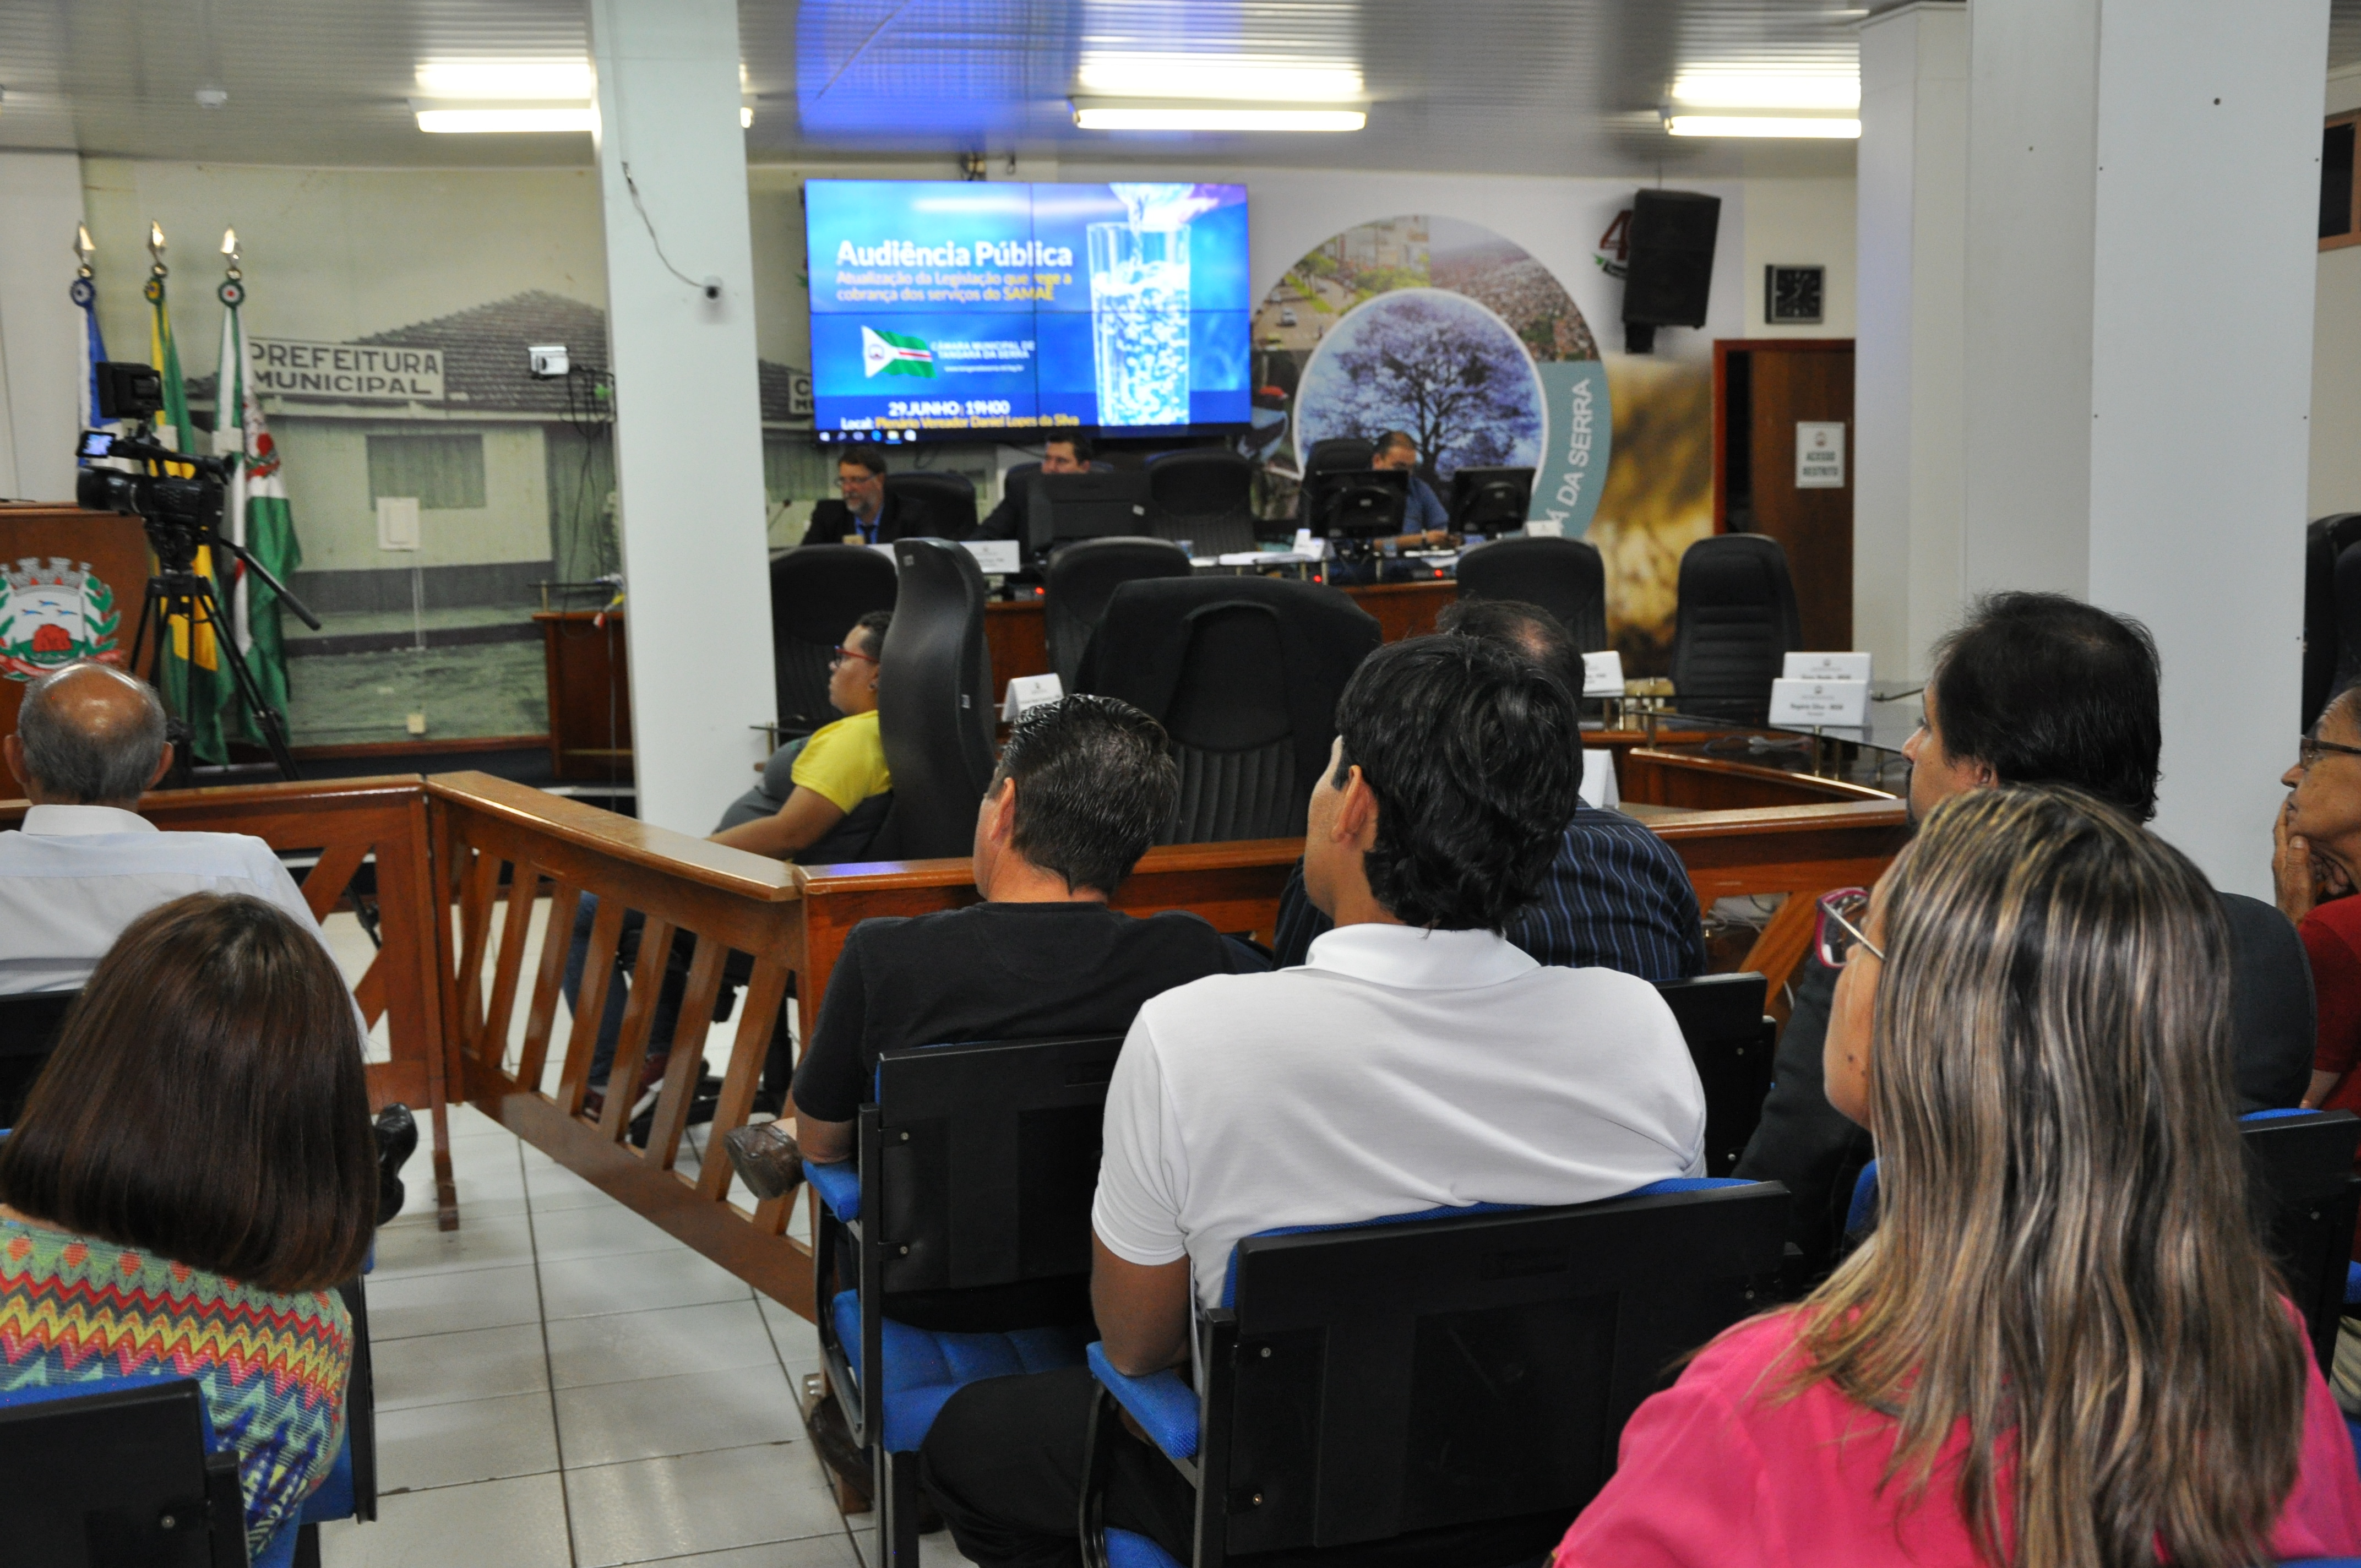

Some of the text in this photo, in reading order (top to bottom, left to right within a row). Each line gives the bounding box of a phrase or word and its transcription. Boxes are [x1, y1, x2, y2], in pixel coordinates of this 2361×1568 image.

[836, 239, 1073, 267] Audiência Pública
[836, 271, 913, 287] Atualização
[915, 271, 932, 285] da
[935, 271, 1002, 287] Legislação
[1003, 274, 1029, 287] que
[1063, 274, 1073, 285] a
[836, 287, 897, 303] cobrança
[900, 287, 924, 301] dos
[927, 287, 981, 303] serviços
[983, 287, 1002, 301] do
[249, 343, 439, 374] PREFEITURA
[255, 369, 432, 395] MUNICIPAL
[920, 416, 969, 428] Vereador
[970, 415, 1005, 428] Daniel
[1006, 415, 1037, 428] Lopes
[1038, 415, 1052, 426] da
[1053, 413, 1079, 426] Silva
[965, 400, 1010, 416] 19H00
[1568, 378, 1593, 467] SERRA
[1556, 471, 1585, 507] DA
